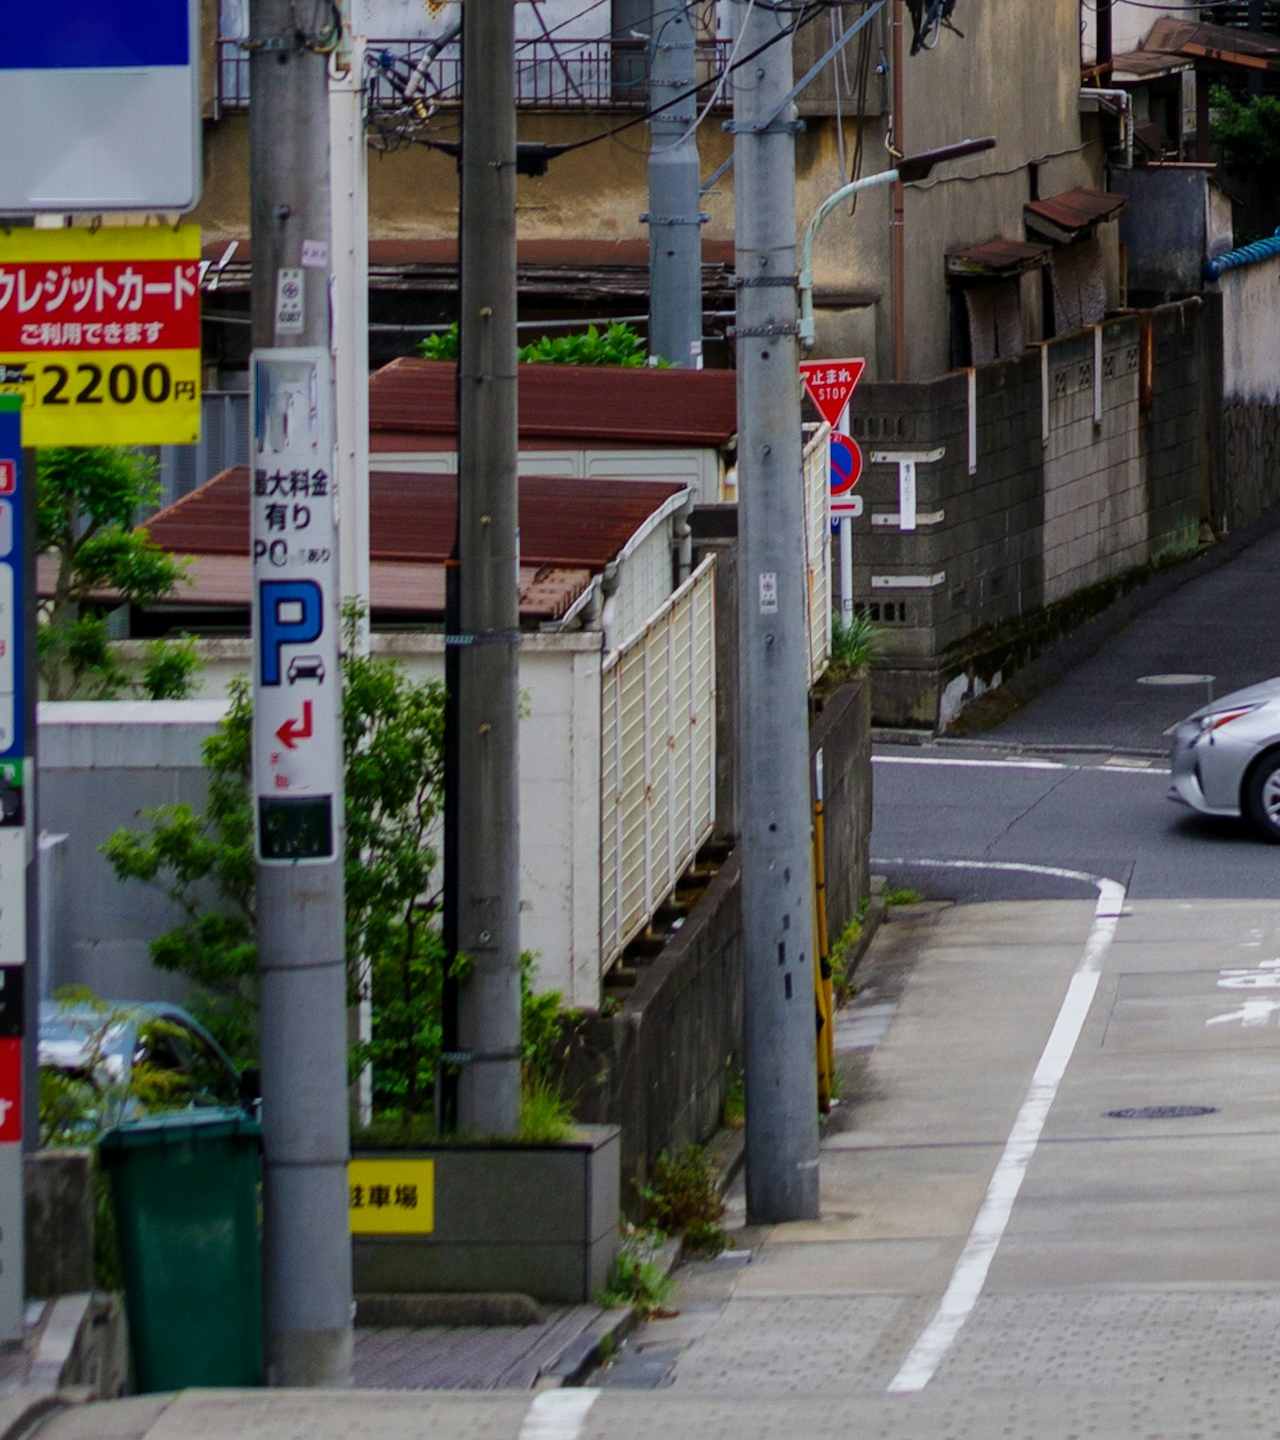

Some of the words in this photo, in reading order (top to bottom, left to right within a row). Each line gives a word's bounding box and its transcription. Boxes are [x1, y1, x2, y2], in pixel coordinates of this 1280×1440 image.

[20, 322, 164, 346] ご利用できます
[811, 369, 852, 385] 止まれ
[818, 388, 847, 401] STOP
[265, 502, 312, 531] 有り
